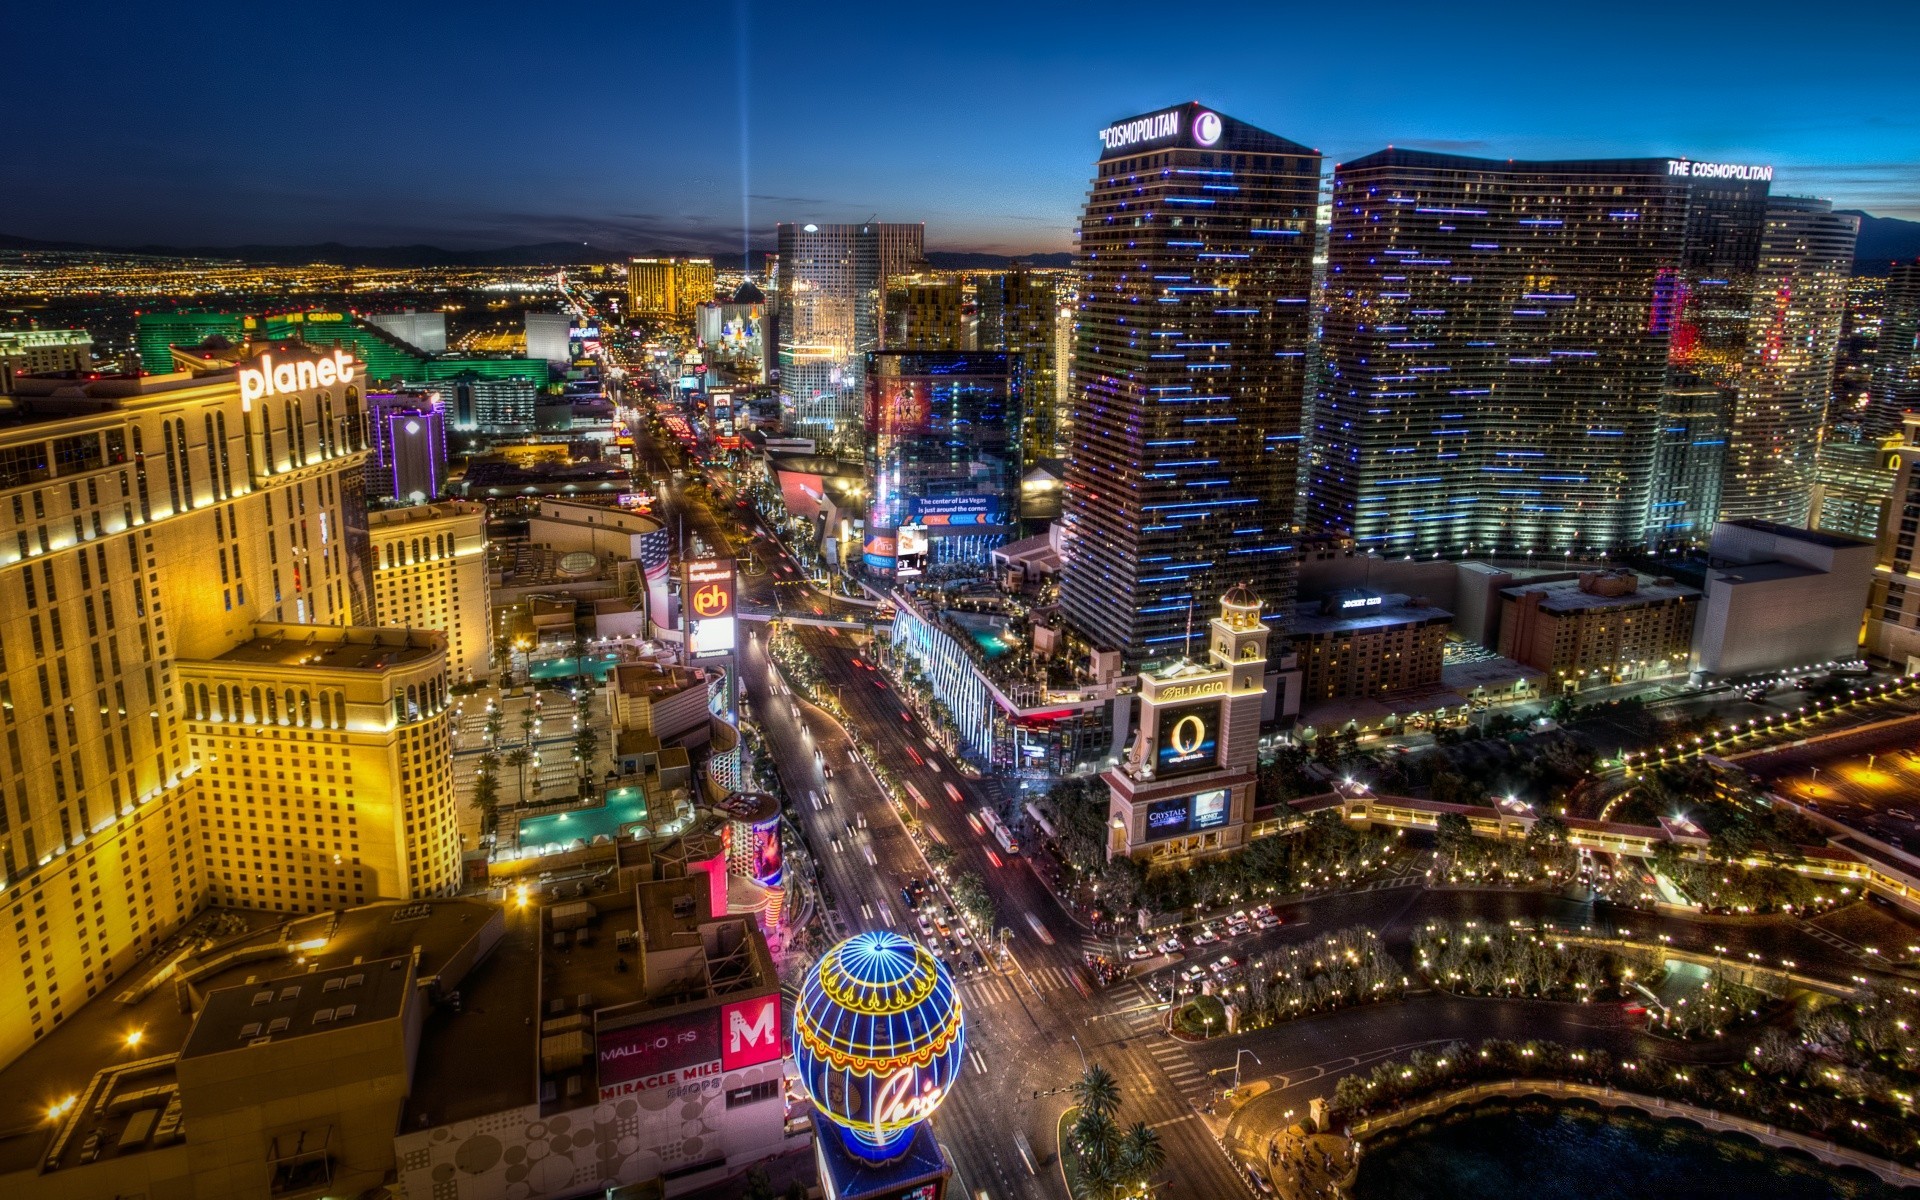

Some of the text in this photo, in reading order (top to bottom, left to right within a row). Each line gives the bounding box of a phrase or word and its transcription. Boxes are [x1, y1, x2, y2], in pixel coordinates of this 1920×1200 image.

[1099, 111, 1178, 149] THE COSMOPOLITAN
[1668, 160, 1773, 181] THE COSMOPOLITAN
[308, 313, 343, 321] GRAND
[569, 327, 599, 337] MGM
[239, 350, 354, 412] planet
[924, 506, 936, 514] just
[969, 497, 987, 505] Vegas
[689, 570, 731, 582] hollywood
[698, 584, 728, 613] ph
[696, 649, 728, 658] Panasonic
[1159, 682, 1224, 700] BELLAGIO
[1171, 715, 1205, 754] O
[1149, 807, 1187, 821] CRYSTALS
[730, 1002, 775, 1054] M
[601, 1030, 697, 1061] MALL HORS
[601, 1062, 720, 1100] MIRACLE MILE
[667, 1077, 722, 1099] SHOPS
[874, 1067, 942, 1146] Paris
